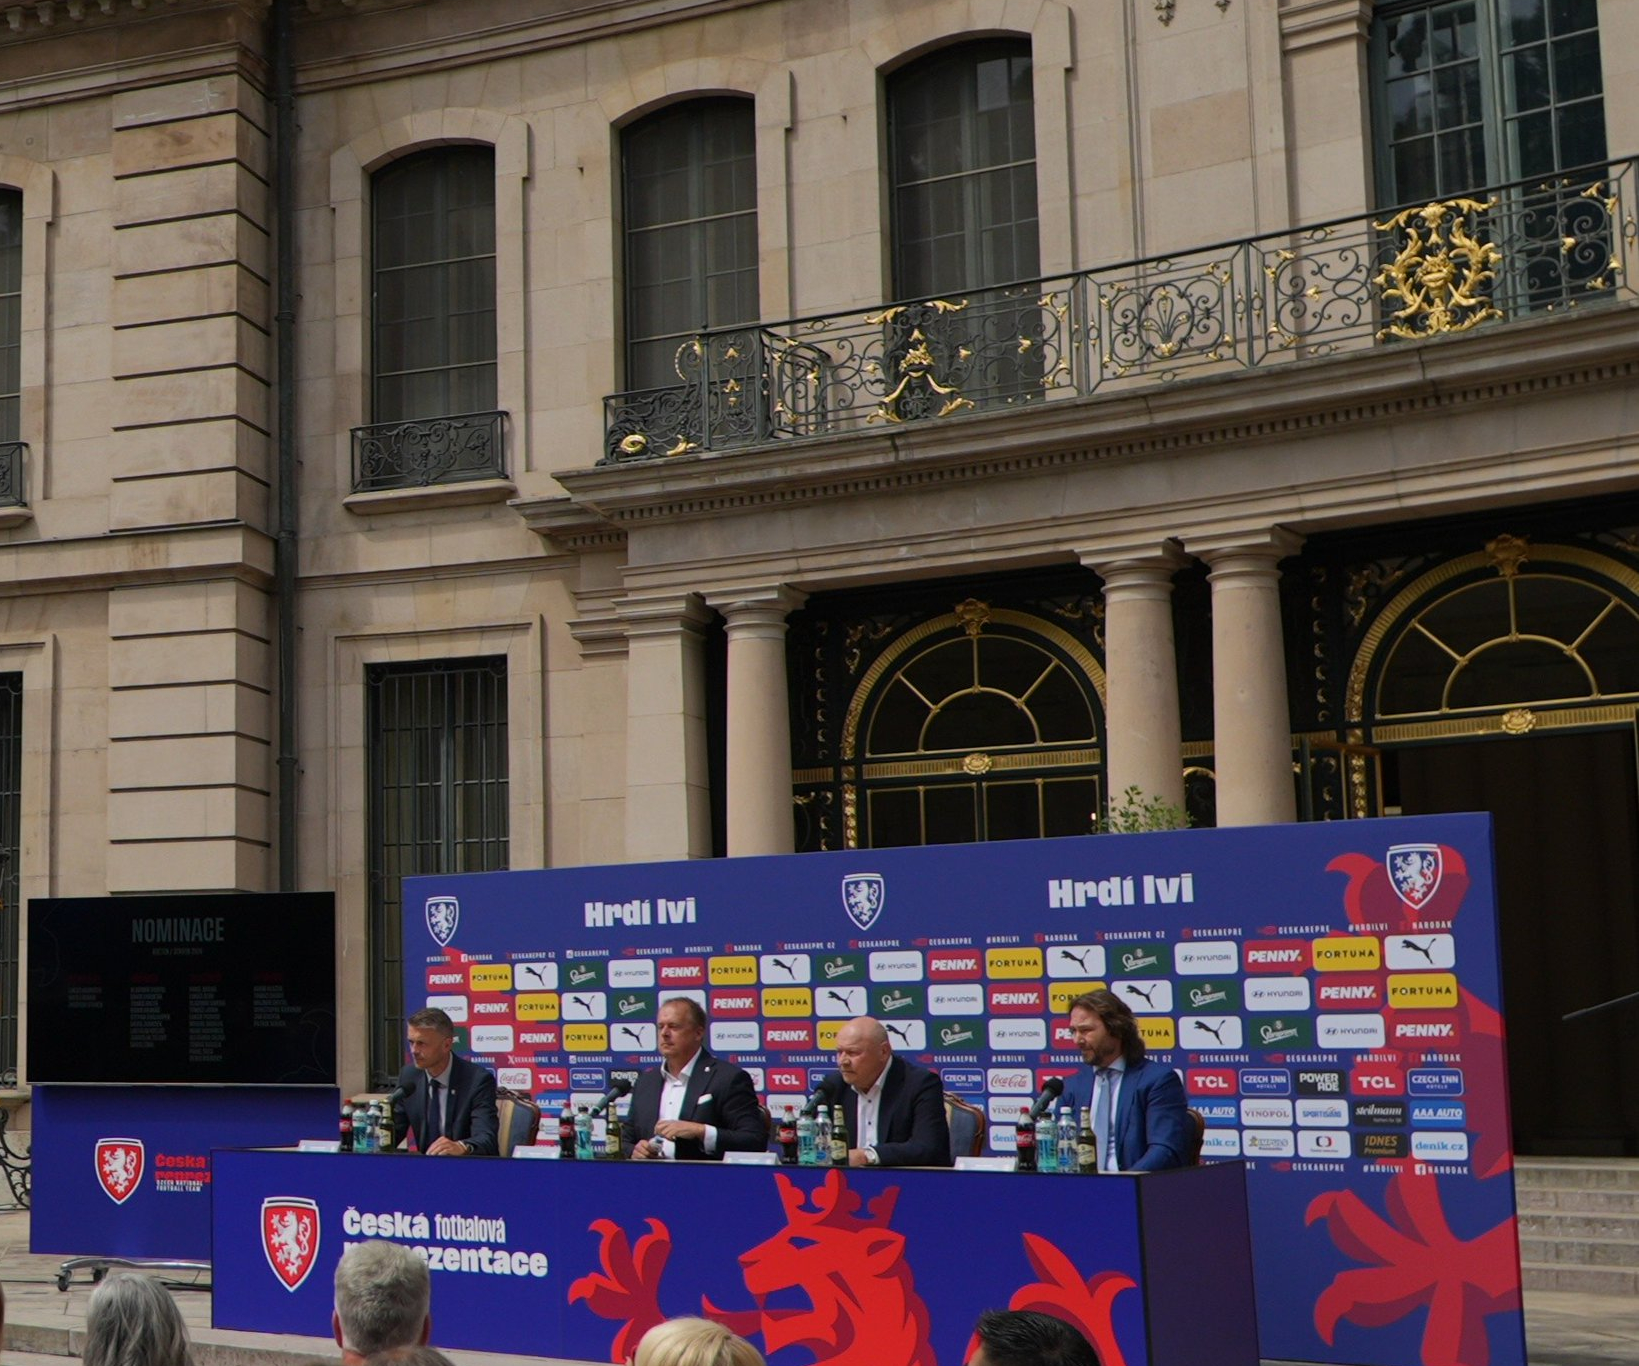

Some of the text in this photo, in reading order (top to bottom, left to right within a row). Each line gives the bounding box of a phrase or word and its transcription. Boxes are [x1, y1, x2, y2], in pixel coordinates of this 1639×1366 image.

[1048, 875, 1135, 908] Hrdí
[584, 899, 651, 927] Hrdí
[1278, 924, 1331, 934] CESKAREPRE
[1412, 920, 1453, 930] NARODAK
[131, 917, 225, 943] NOMINACE
[1044, 933, 1078, 942] NARODAK
[1316, 949, 1375, 958] FORTUNA
[989, 959, 1039, 967] FORTUNA
[711, 966, 754, 975] FORTUNA
[472, 973, 509, 981] FORTUNA
[1391, 986, 1452, 996] FORTUNA
[518, 1003, 556, 1011] FORTUNA
[764, 998, 808, 1007] FORTUNA
[565, 1033, 604, 1041] FORTUNA
[1141, 1029, 1170, 1037] TUNA
[1285, 1054, 1338, 1063] CESKAREPRE
[1420, 1053, 1461, 1062] NARODAK
[538, 1074, 563, 1084] TCL
[771, 1074, 800, 1085] TCL
[944, 1074, 966, 1083] CZECH
[1194, 1076, 1229, 1088] TCL
[1243, 1075, 1287, 1084] CZECH INN
[1299, 1073, 1339, 1083] POWER
[1358, 1076, 1396, 1089] TCL
[1411, 1075, 1459, 1084] CZECH INN
[1317, 1082, 1340, 1092] ADE
[1211, 1106, 1236, 1116] AUTO
[1244, 1110, 1290, 1118] VINOPOL
[1355, 1104, 1402, 1116] steilmann
[1412, 1108, 1463, 1117] AAA AUTO
[1205, 1138, 1237, 1147] nik.cz
[1292, 1163, 1345, 1172] CESKAREPRE
[1427, 1165, 1468, 1175] NARODAK
[342, 1205, 506, 1244] Česká fotbalová
[343, 1241, 549, 1278] ezentace
